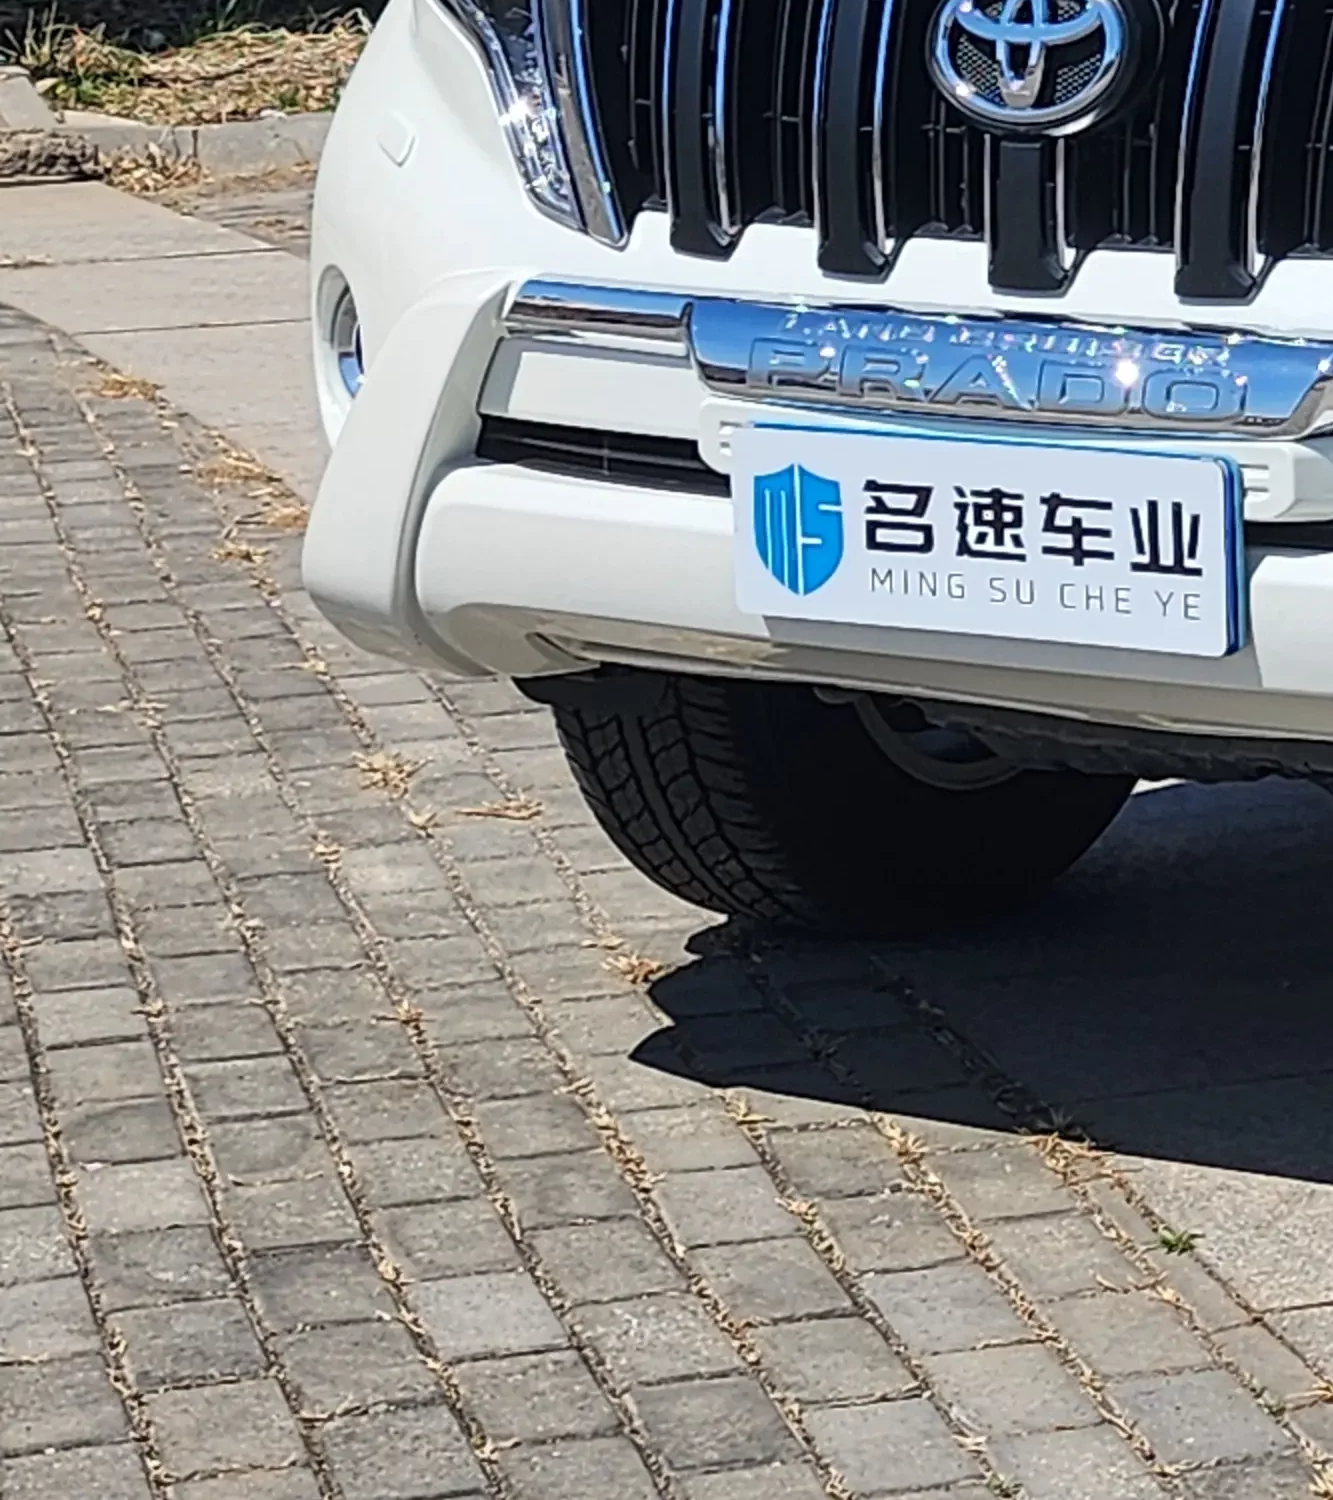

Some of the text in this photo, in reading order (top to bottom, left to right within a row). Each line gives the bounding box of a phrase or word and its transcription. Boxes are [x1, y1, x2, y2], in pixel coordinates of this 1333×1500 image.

[747, 336, 1248, 423] PRADO
[863, 479, 1203, 577] 名速车业
[869, 567, 1202, 621] MING SU CHE YE
